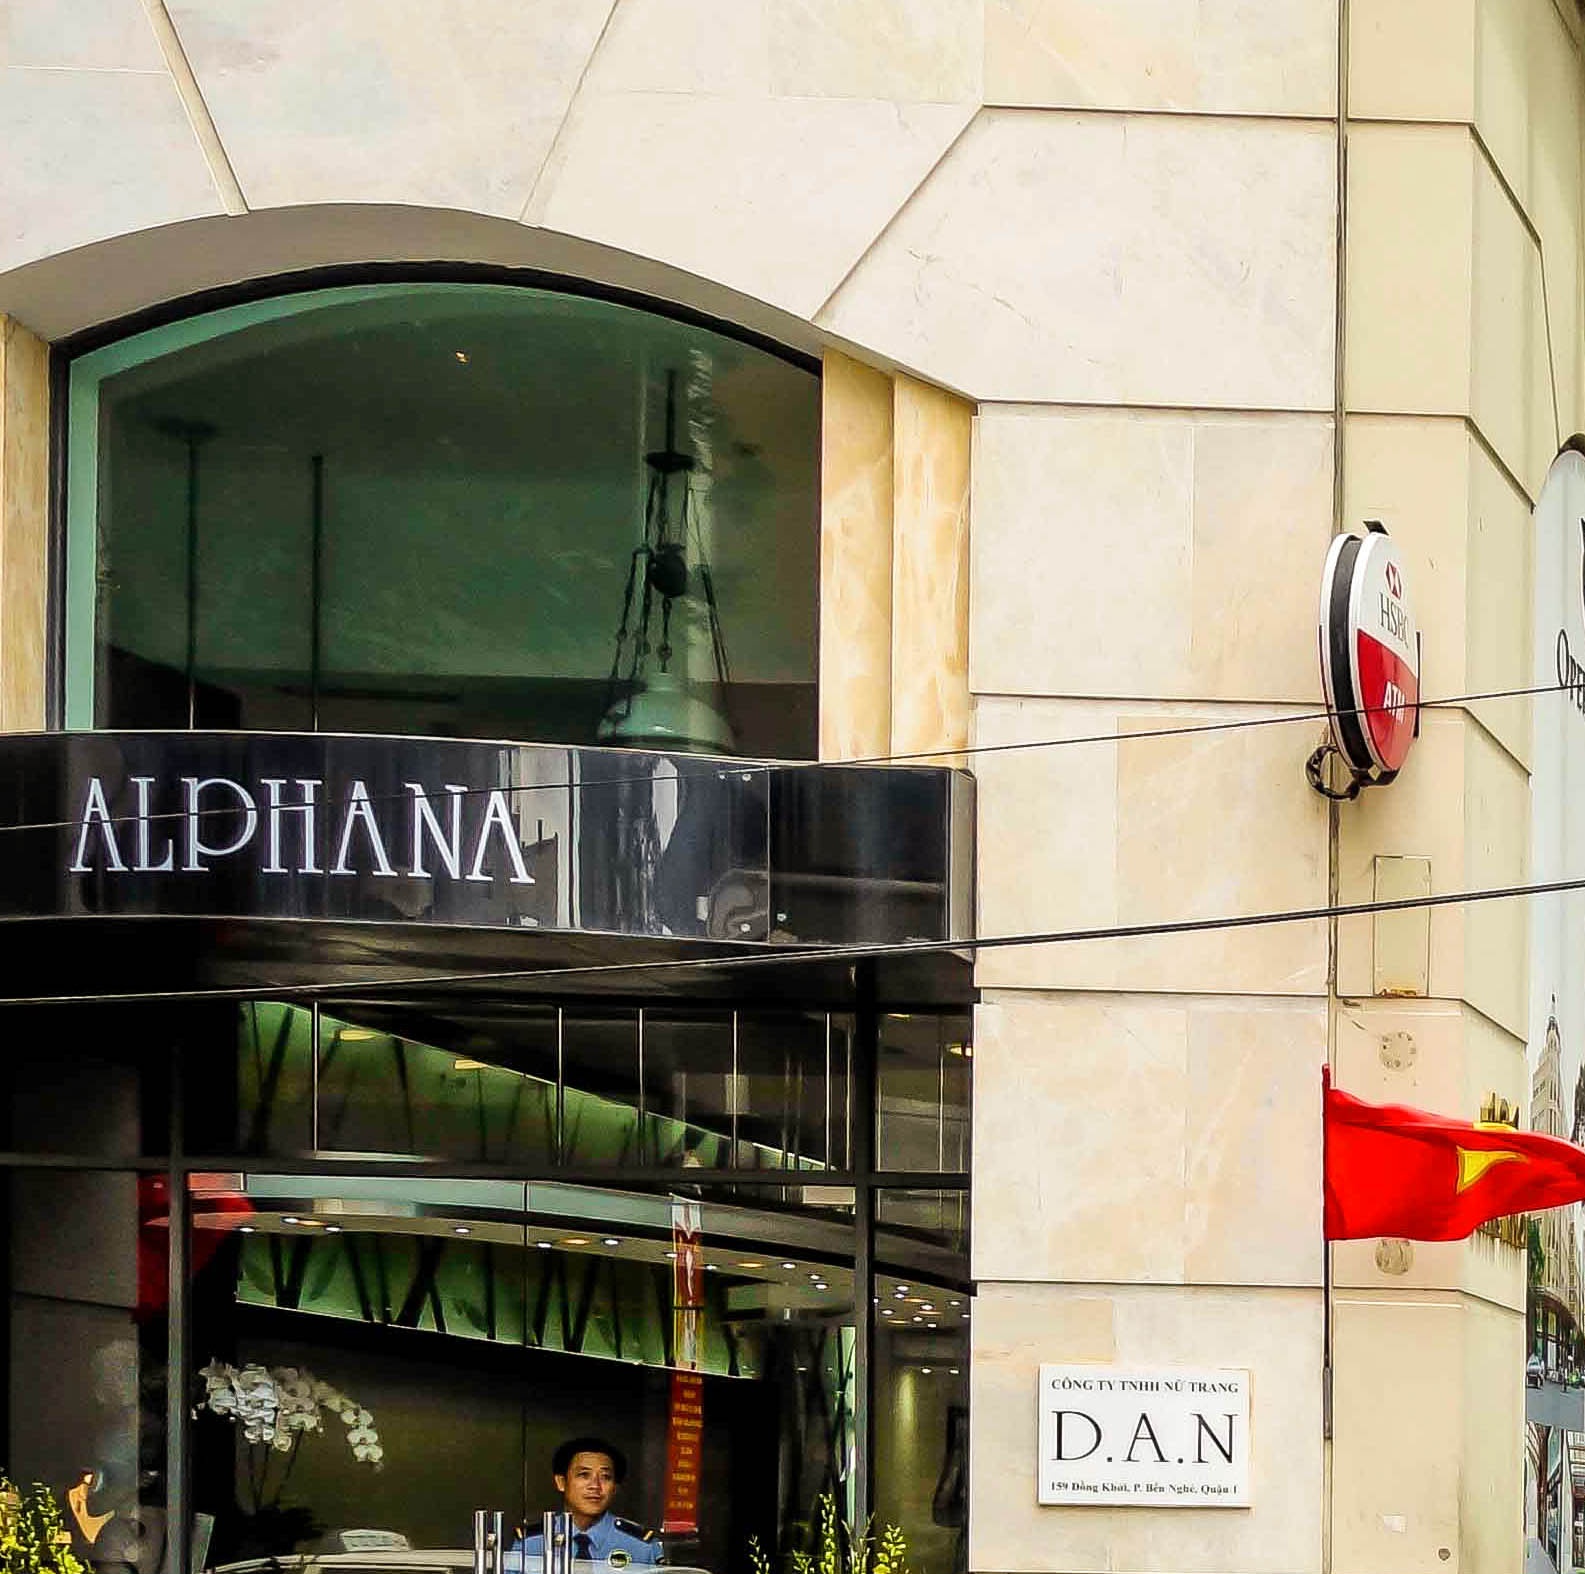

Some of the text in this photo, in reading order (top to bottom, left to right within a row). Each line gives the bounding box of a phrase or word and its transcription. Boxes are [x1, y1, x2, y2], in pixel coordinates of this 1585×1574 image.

[1378, 592, 1409, 649] HSBC
[1383, 680, 1406, 725] ATM
[69, 776, 536, 884] ALPHANA
[1051, 1377, 1094, 1392] CÔNG
[1096, 1380, 1115, 1392] TY
[1119, 1380, 1160, 1392] TNHH
[1188, 1381, 1239, 1394] TRANG
[1051, 1410, 1239, 1465] D.A.N
[1051, 1482, 1069, 1492] 159
